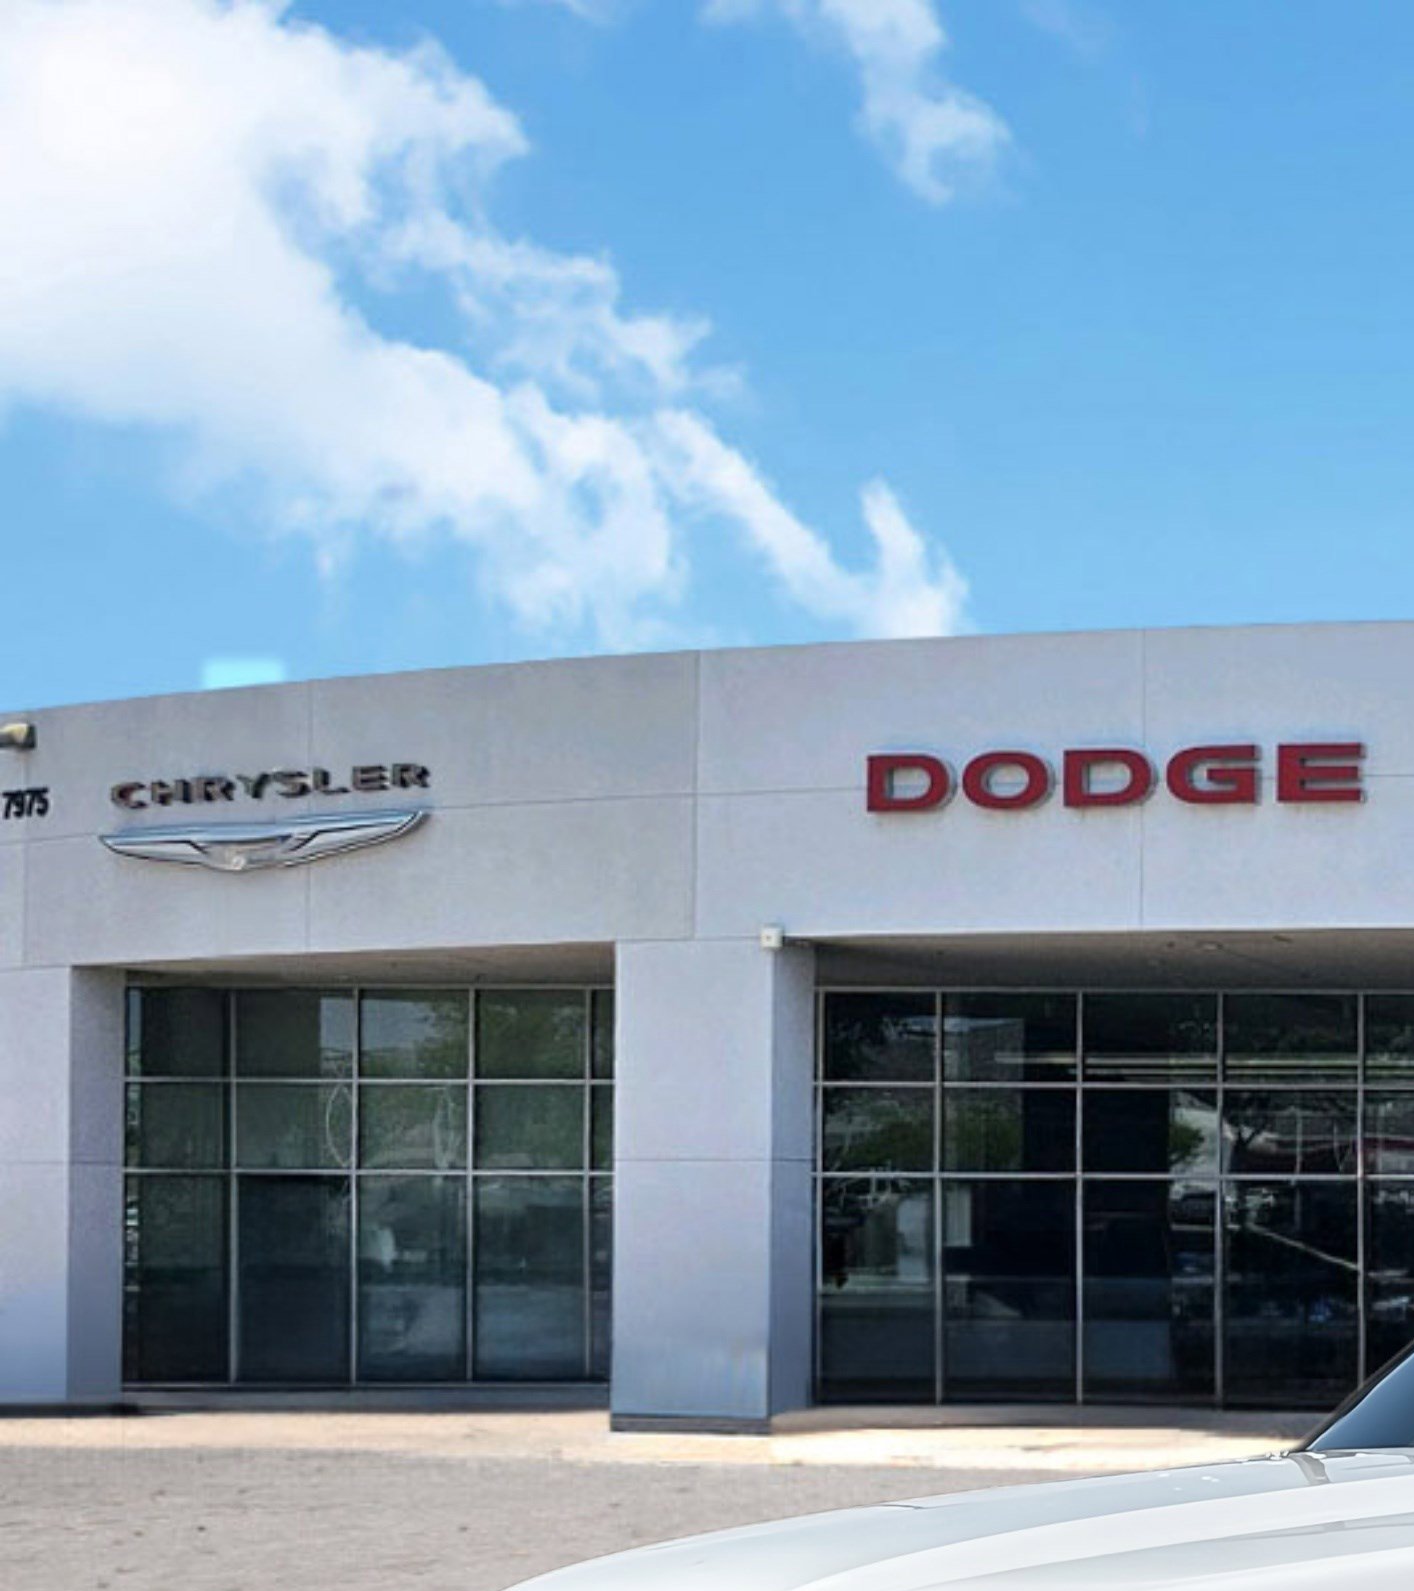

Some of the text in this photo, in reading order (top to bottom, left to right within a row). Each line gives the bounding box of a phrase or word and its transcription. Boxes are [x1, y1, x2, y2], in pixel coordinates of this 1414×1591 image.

[110, 762, 431, 811] CHRYSLER
[866, 742, 1367, 813] DODGE
[2, 787, 50, 820] 7975
